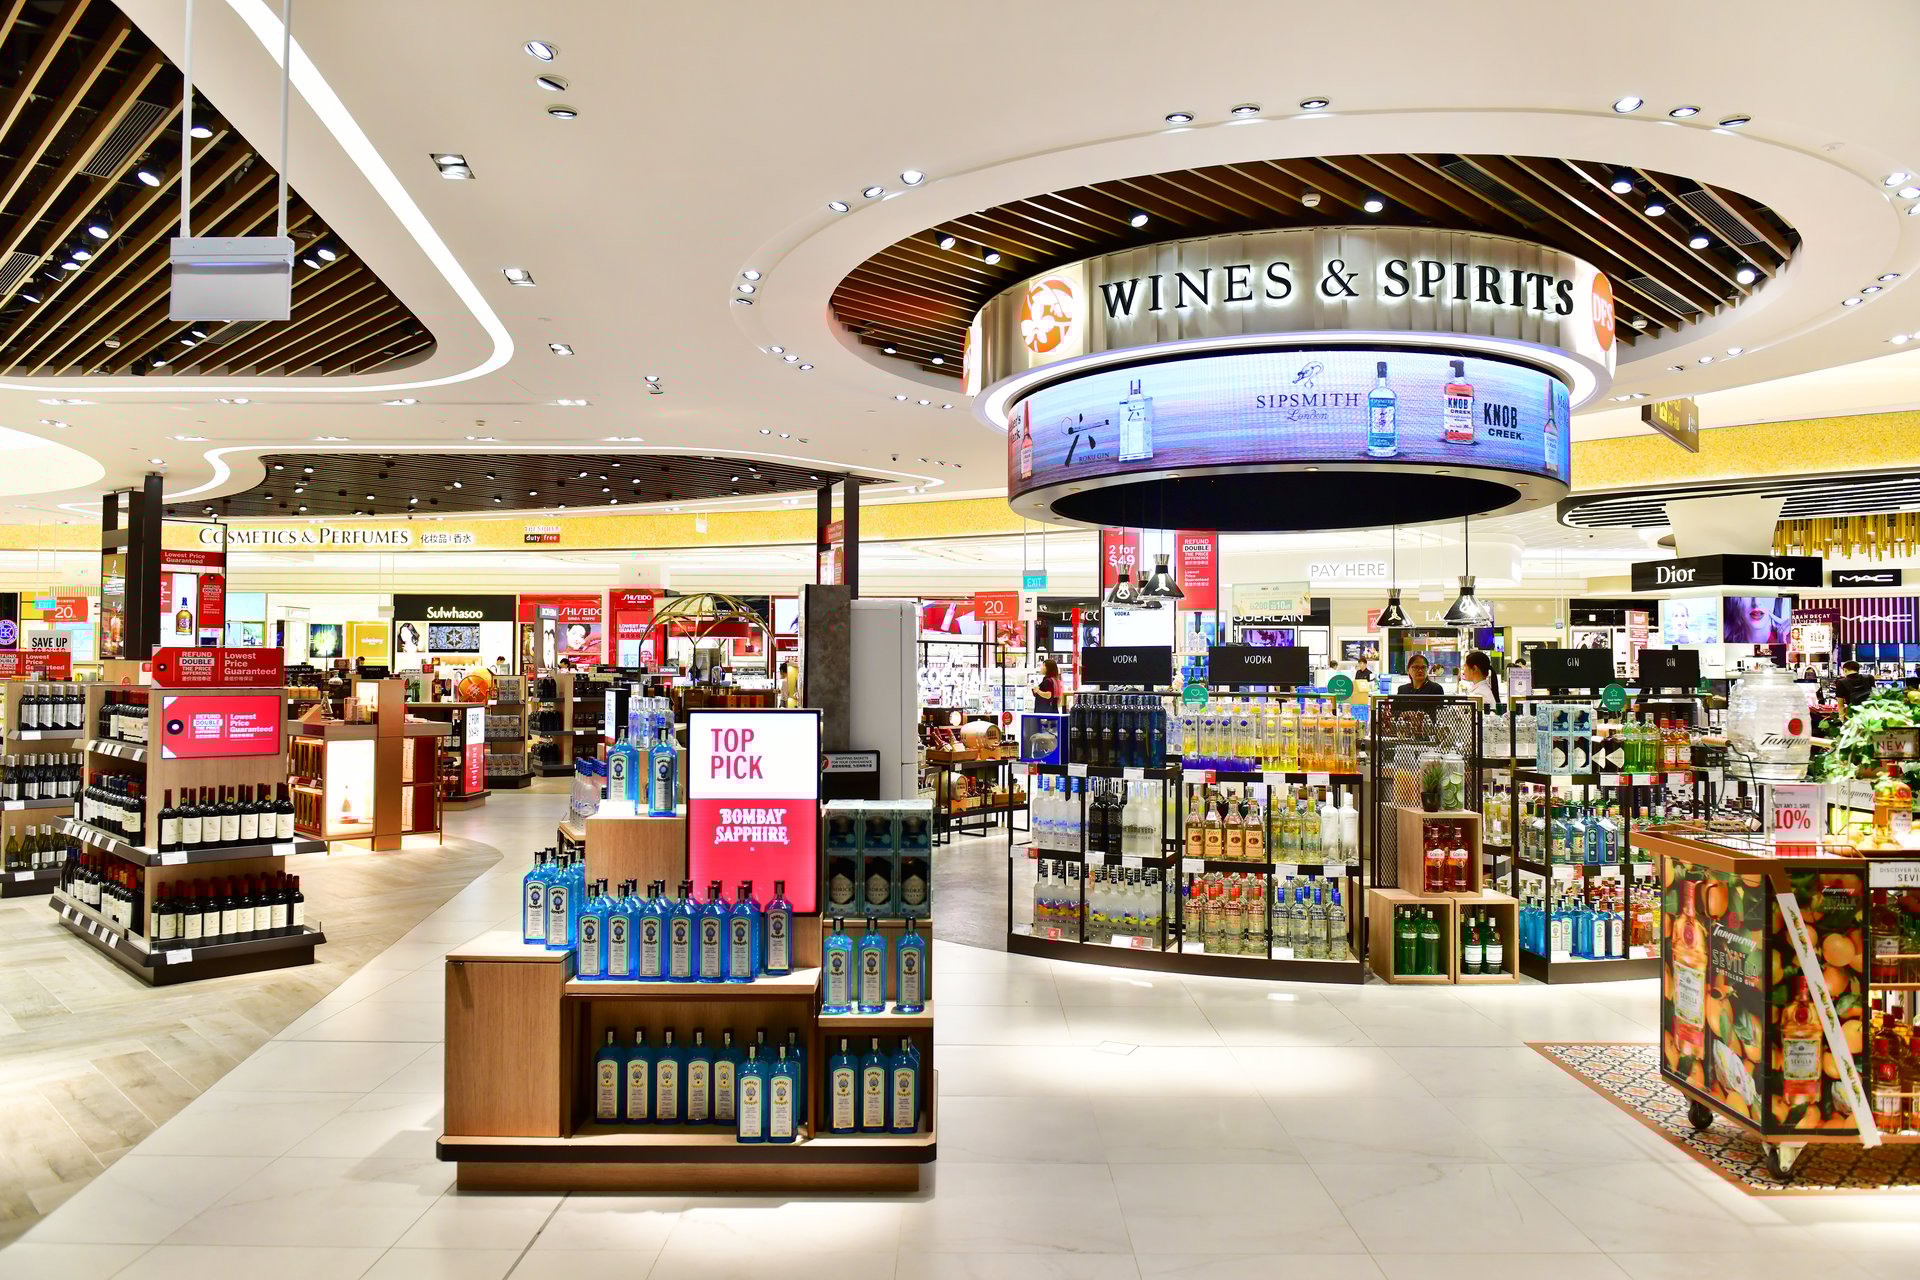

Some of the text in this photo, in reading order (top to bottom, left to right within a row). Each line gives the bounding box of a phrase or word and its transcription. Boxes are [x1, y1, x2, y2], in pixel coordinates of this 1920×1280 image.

[1098, 258, 1574, 318] WINES & SPIRITS
[1592, 292, 1614, 332] DFS
[1256, 393, 1359, 409] SIPSMITH
[1448, 397, 1468, 410] KNOB
[1286, 408, 1329, 422] London
[1484, 402, 1518, 429] KNOB
[198, 527, 409, 545] COSMETICS & PERFUMES
[420, 533, 472, 544] 化妆品 香水
[526, 534, 541, 543] duty
[164, 551, 187, 559] Lowest
[1108, 544, 1136, 554] 2 for
[166, 557, 204, 565] Guaranteed
[1109, 554, 1136, 566] $49
[1310, 563, 1385, 578] PAY HERE
[1656, 566, 1696, 584] Dior
[1751, 561, 1796, 581] Dior
[1027, 577, 1042, 587] EXIT
[38, 601, 53, 609] EXIT
[984, 600, 1004, 614] 20
[54, 606, 73, 618] 20
[427, 606, 484, 620] Sulwhasoo
[31, 637, 68, 648] SAVE UP
[224, 651, 257, 660] Lowest
[1112, 654, 1138, 664] VODKA
[1244, 654, 1273, 665] VODKA
[224, 659, 248, 667] Price
[1566, 657, 1580, 667] GIN
[1666, 657, 1676, 667] GIN
[224, 667, 277, 676] Guaranteed
[710, 727, 755, 753] TOP
[1876, 740, 1906, 751] NEW
[710, 755, 764, 779] PICK
[719, 807, 787, 825] BOMBAY
[1774, 809, 1811, 830] 10%
[714, 825, 790, 845] SAPPHIRE
[1821, 885, 1856, 895] Tanqueray
[1713, 922, 1757, 952] Tanqueray
